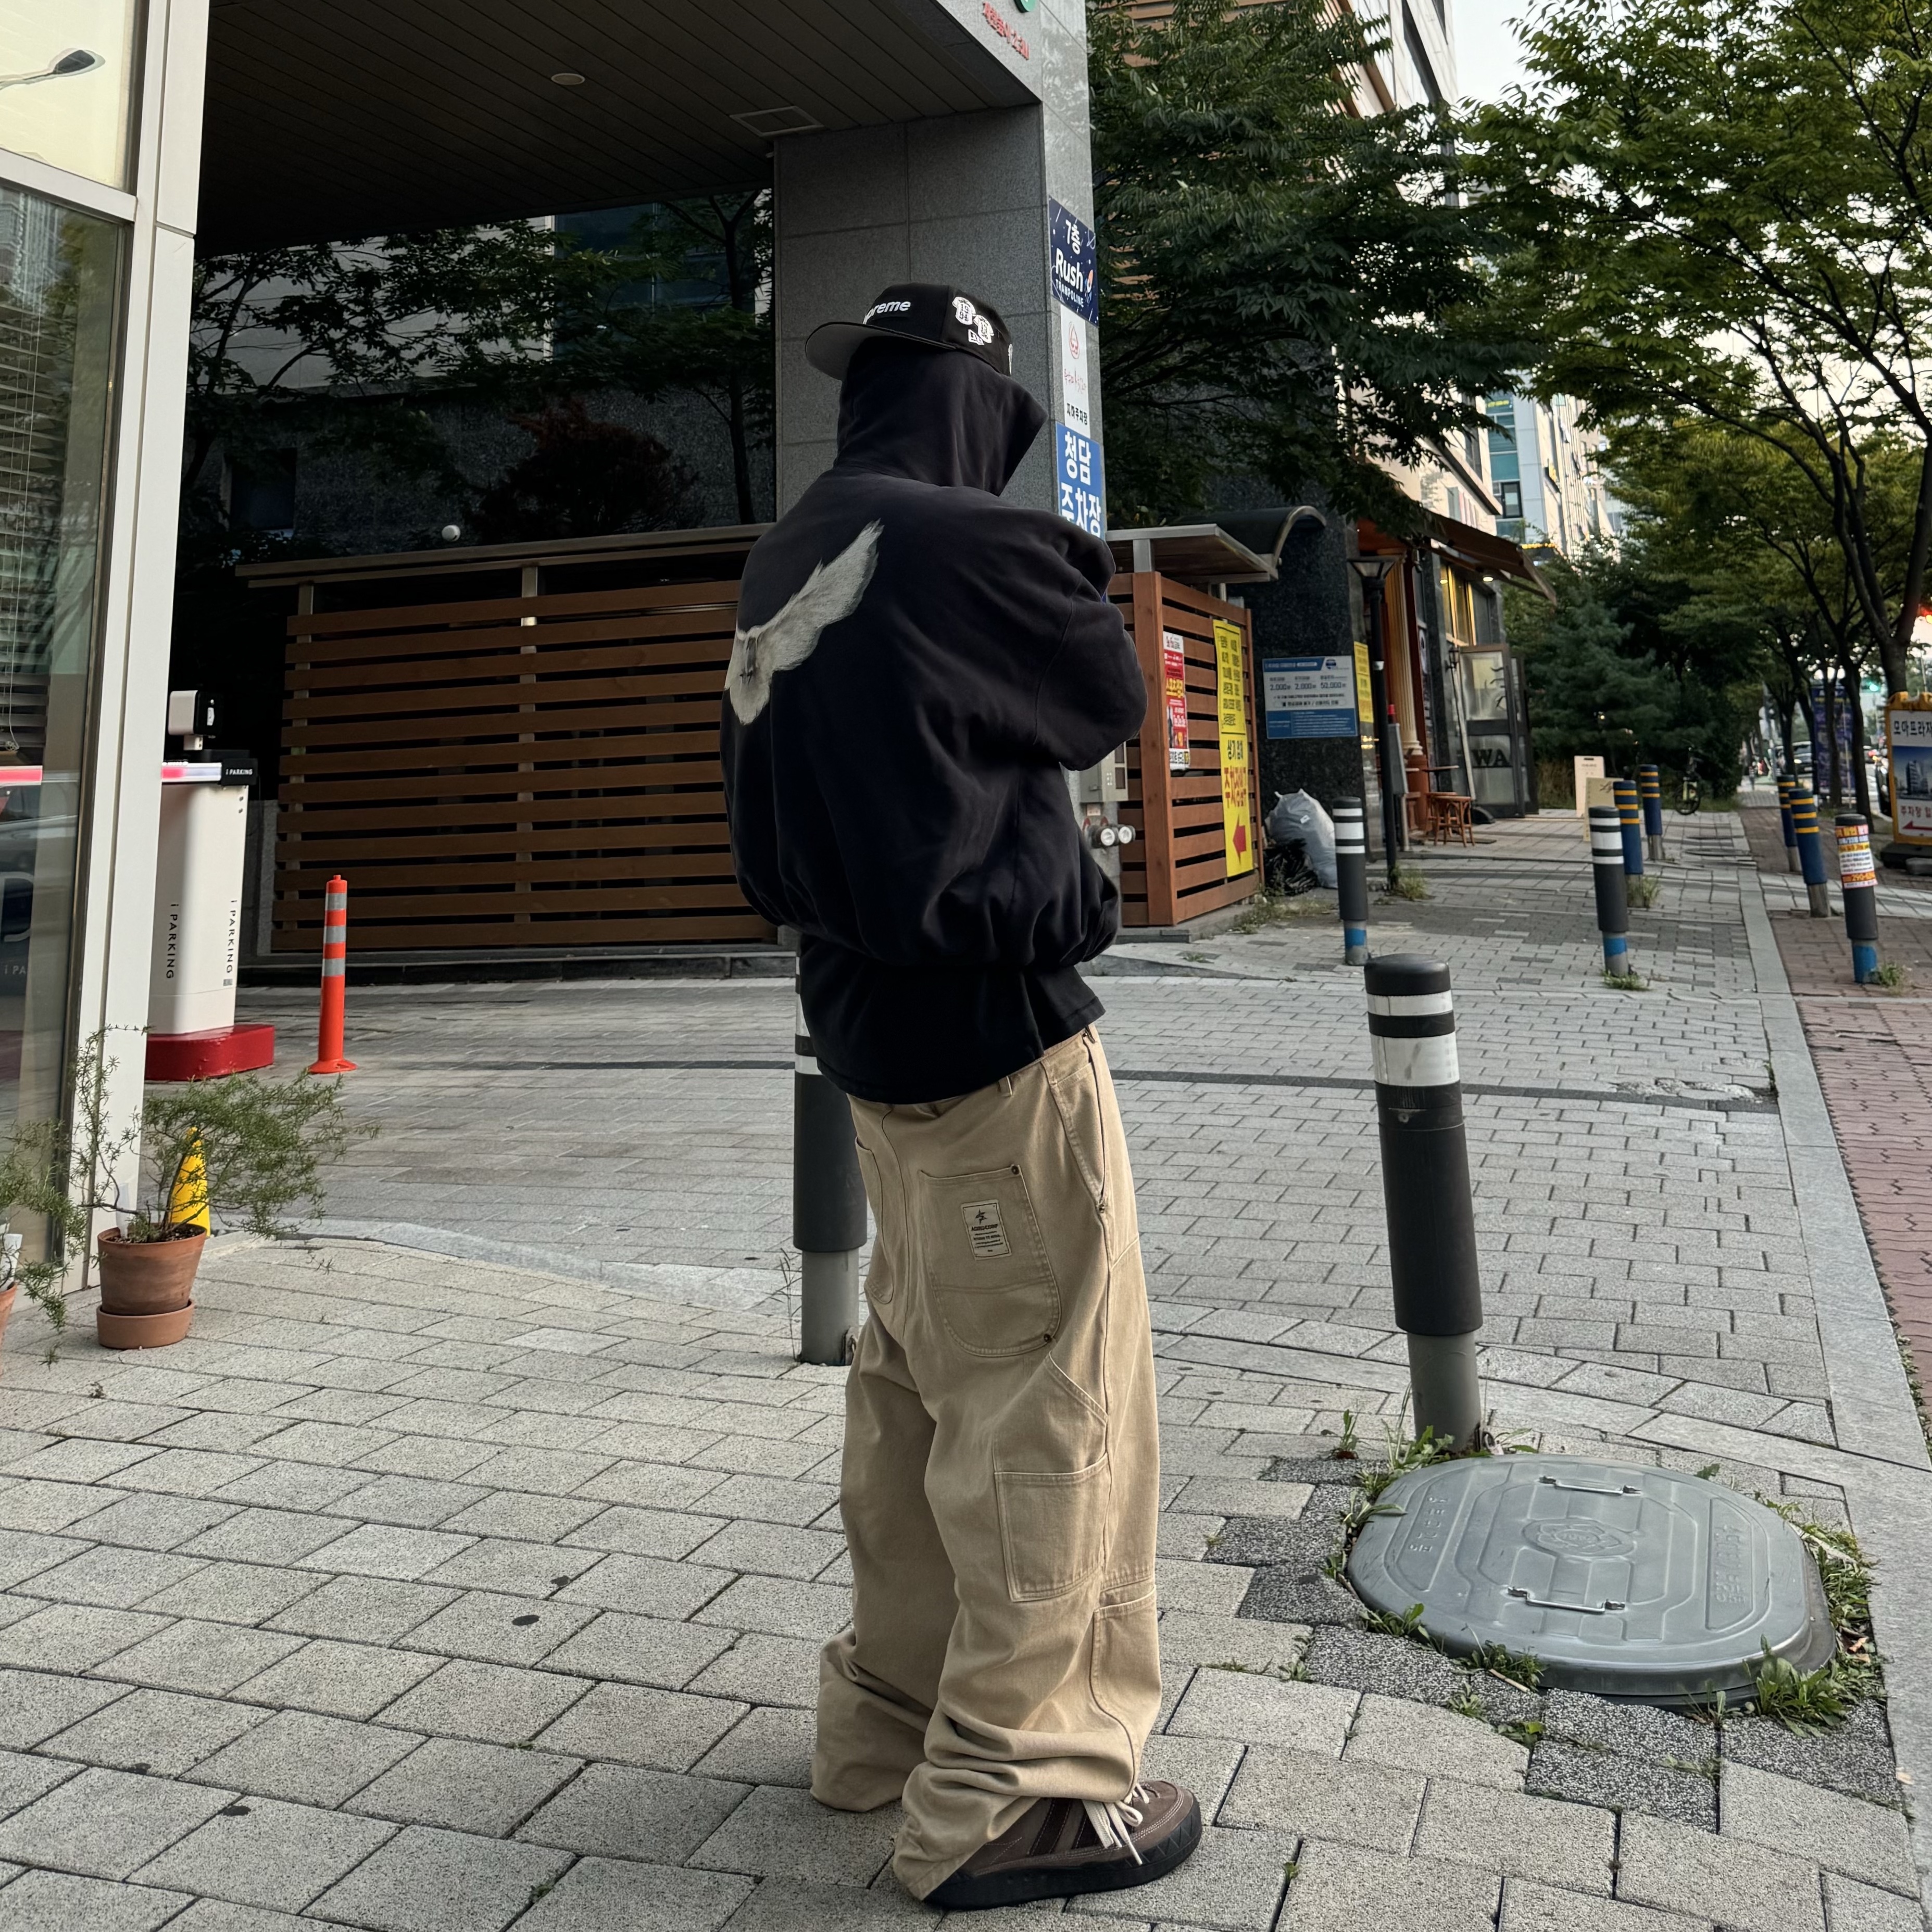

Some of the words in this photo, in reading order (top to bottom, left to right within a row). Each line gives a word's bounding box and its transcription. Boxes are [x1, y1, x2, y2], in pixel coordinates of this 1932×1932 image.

[1056, 248, 1084, 292] Rush
[1056, 279, 1084, 308] TRAMPOLINE
[1064, 431, 1091, 485] 청담
[1061, 482, 1101, 538] 주차장
[166, 914, 178, 978] PARKING
[227, 910, 236, 973] PARKING
